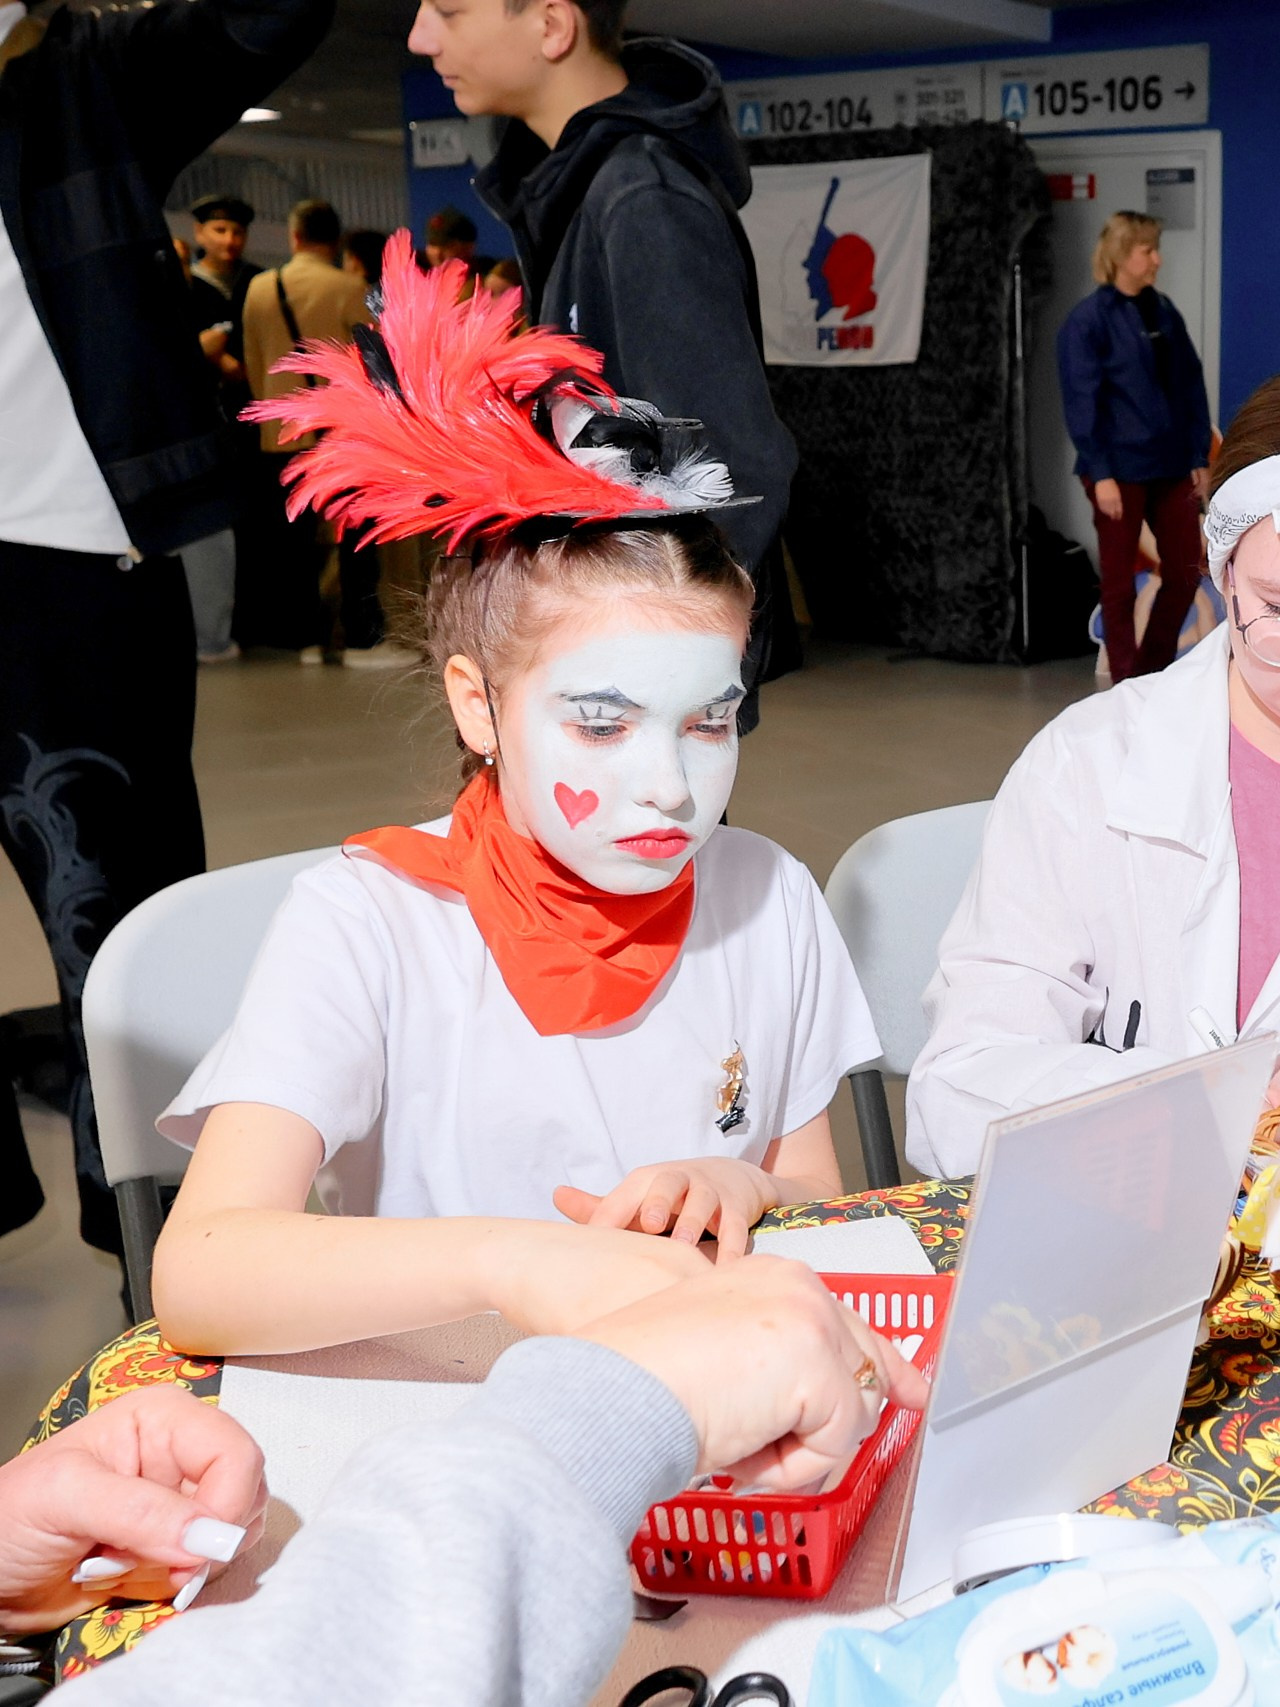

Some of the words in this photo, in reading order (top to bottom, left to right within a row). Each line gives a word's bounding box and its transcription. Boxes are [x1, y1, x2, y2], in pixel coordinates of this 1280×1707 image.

[767, 95, 872, 132] 102-104
[1034, 74, 1163, 117] 105-106
[1127, 1659, 1206, 1697] Влажные
